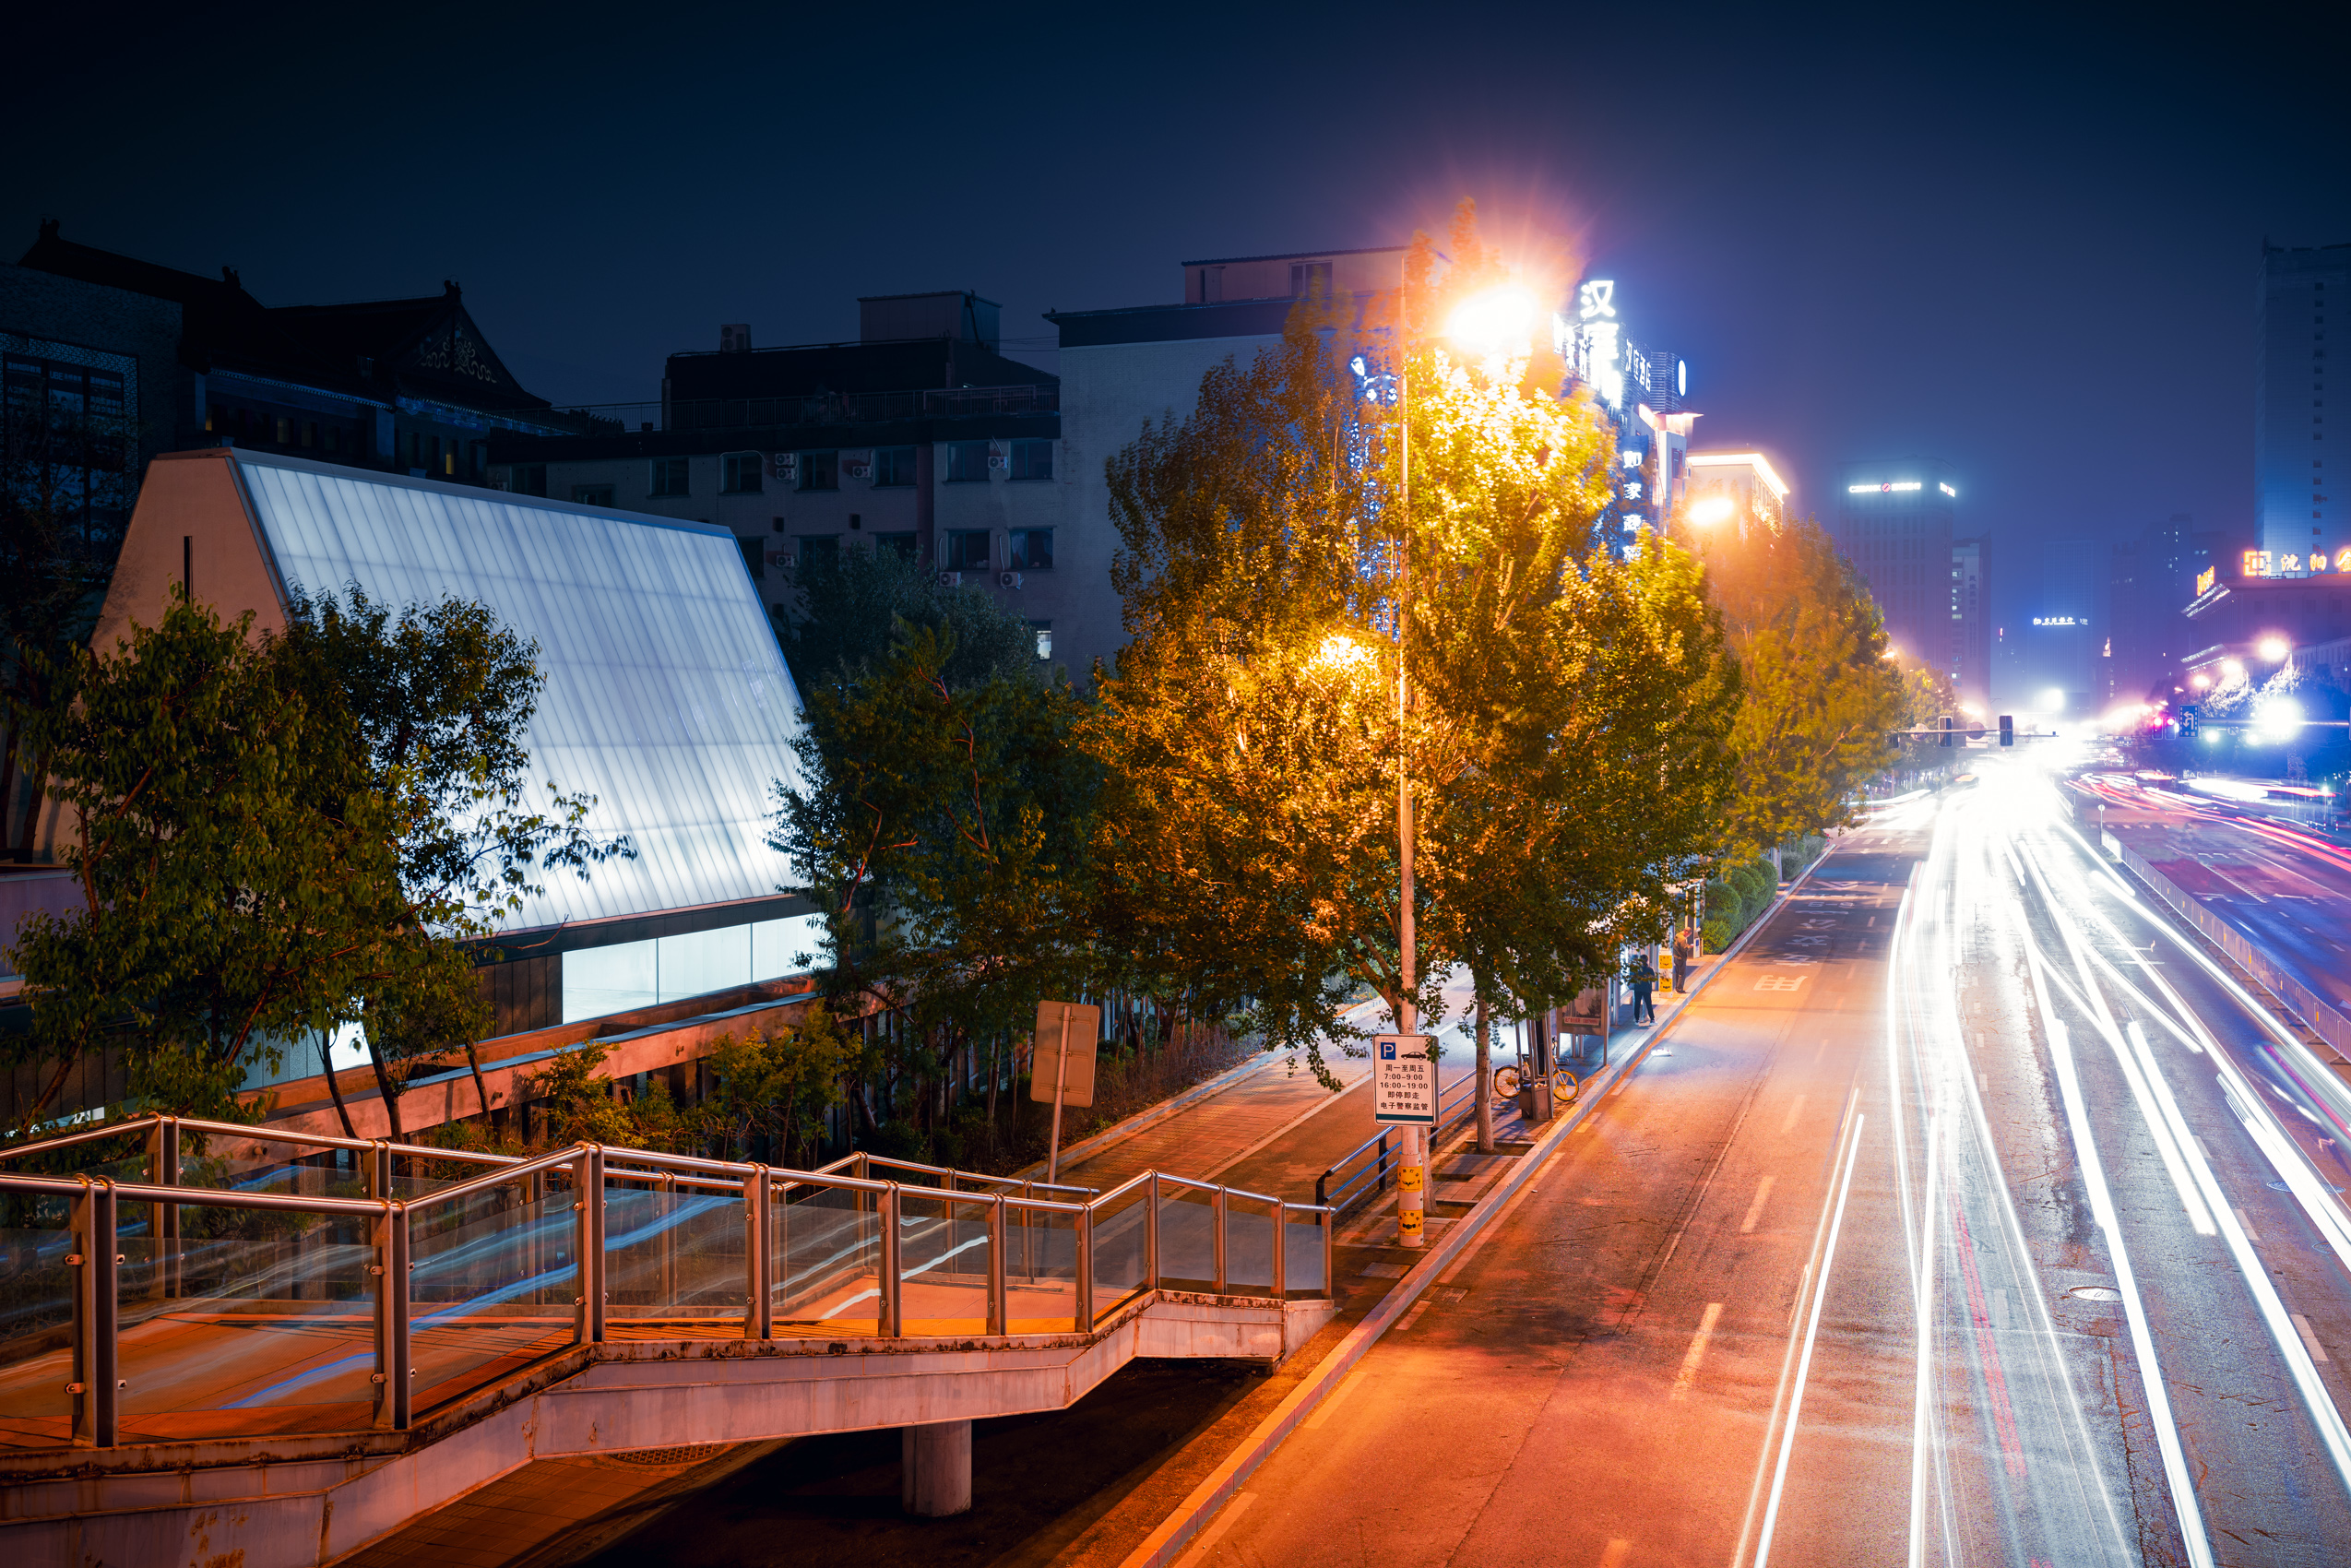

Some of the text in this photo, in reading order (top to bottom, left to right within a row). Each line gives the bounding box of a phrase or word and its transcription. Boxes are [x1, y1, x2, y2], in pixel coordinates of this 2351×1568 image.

[1383, 1044, 1394, 1057] P
[1388, 1091, 1419, 1099] 即停即走
[1381, 1102, 1428, 1111] 电子警察监管
